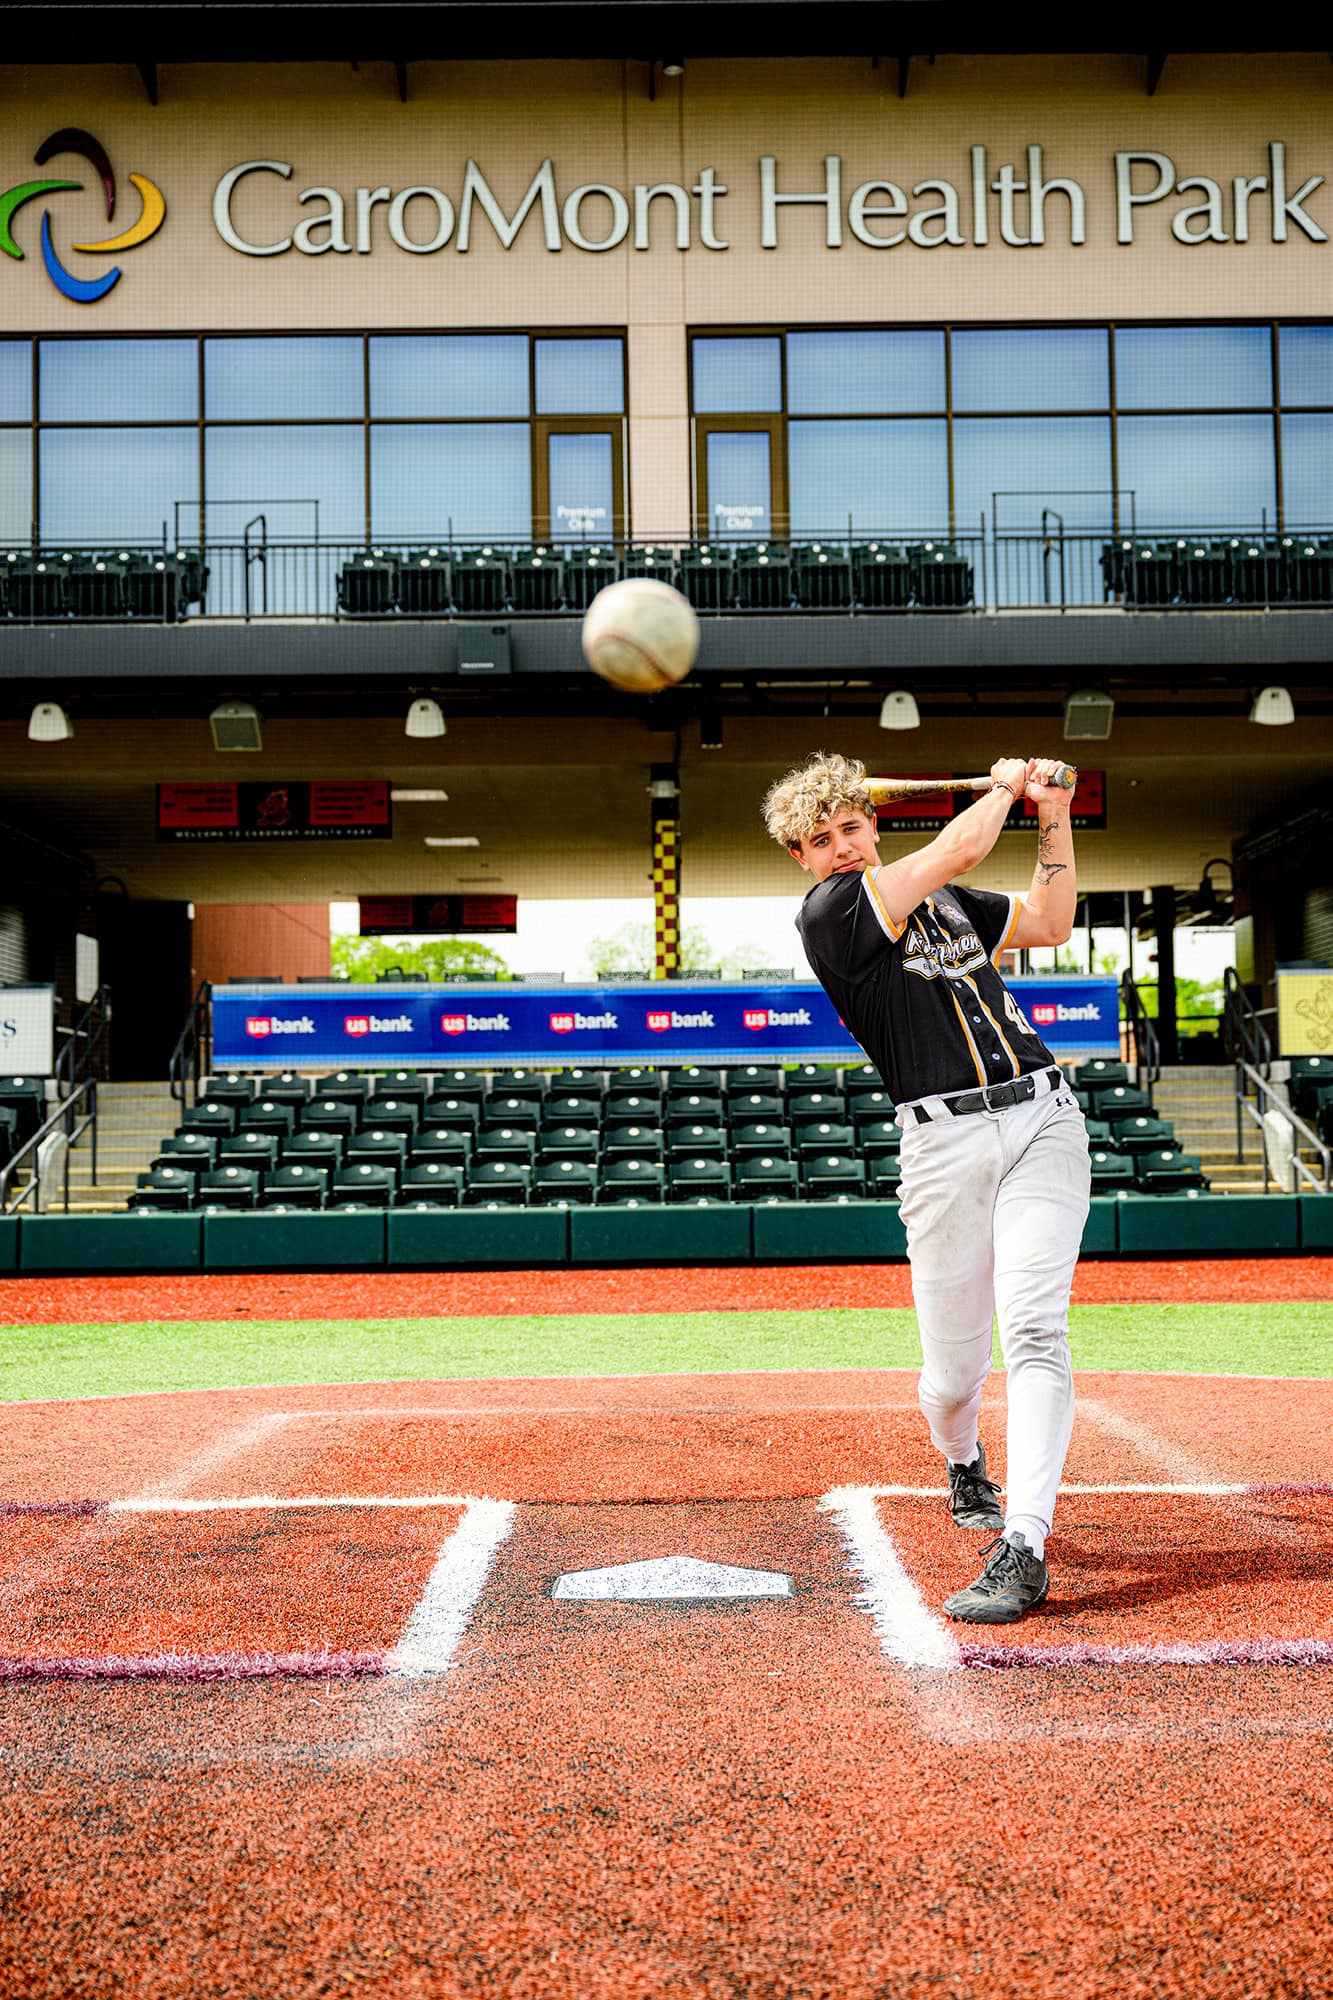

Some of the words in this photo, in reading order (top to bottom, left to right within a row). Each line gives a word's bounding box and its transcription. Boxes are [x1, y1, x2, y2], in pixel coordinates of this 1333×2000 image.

[212, 156, 730, 257] CaroMont
[759, 144, 1087, 250] Health
[1113, 140, 1330, 247] Park
[714, 504, 764, 517] Premium
[726, 517, 753, 530] Club
